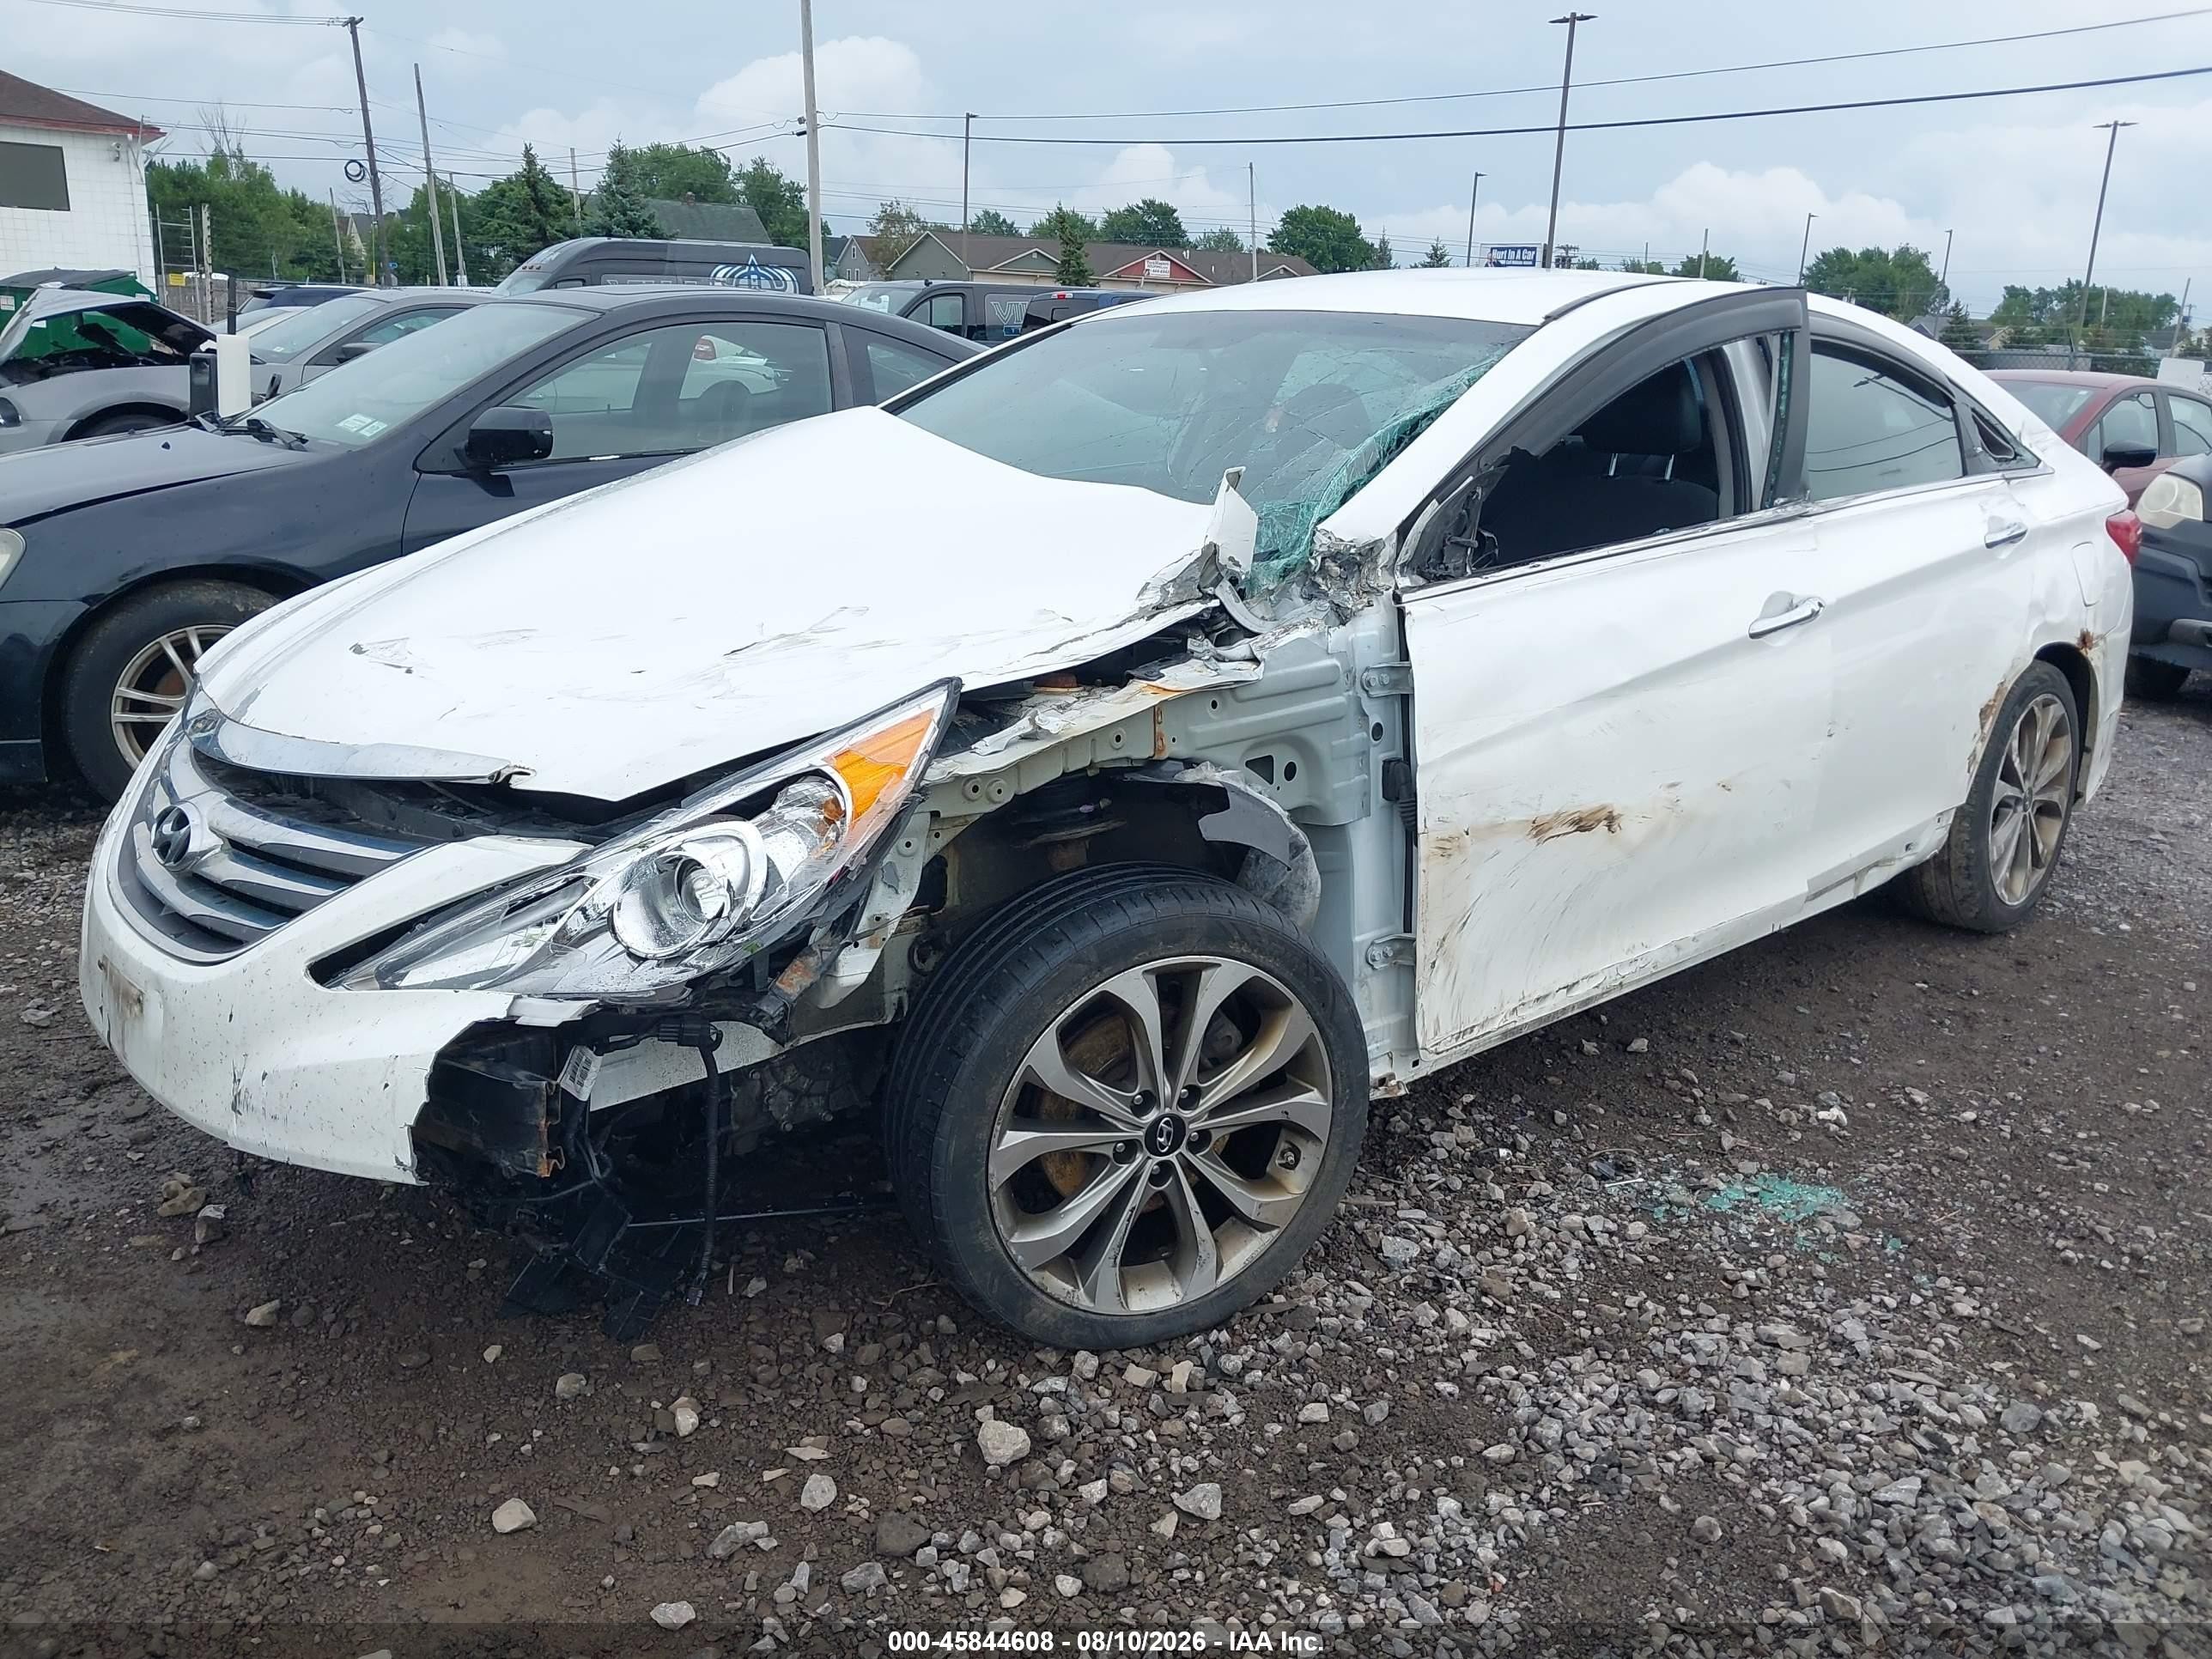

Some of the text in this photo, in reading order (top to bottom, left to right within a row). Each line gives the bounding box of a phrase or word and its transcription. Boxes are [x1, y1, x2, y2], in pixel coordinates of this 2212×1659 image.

[1492, 248, 1535, 260] Hurt In A Car
[990, 301, 1029, 325] VI
